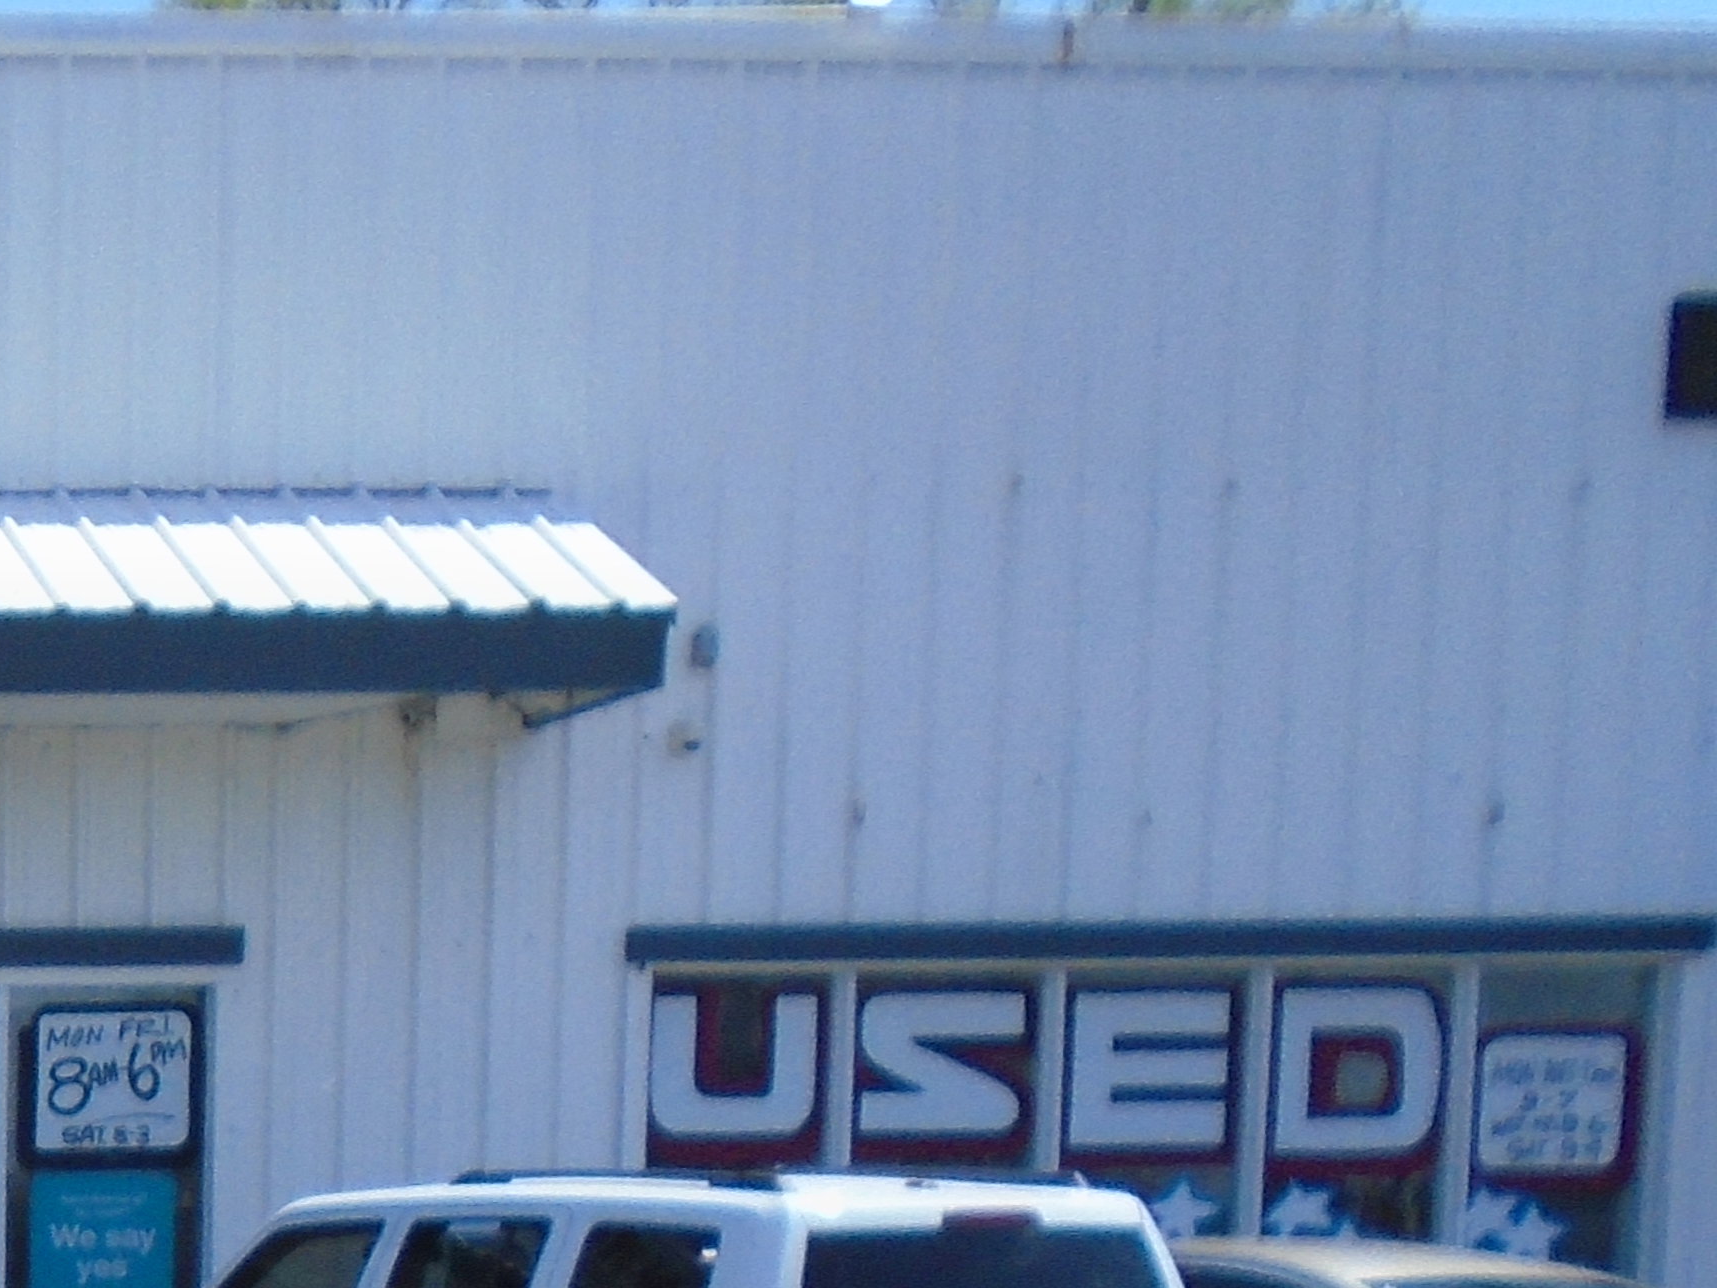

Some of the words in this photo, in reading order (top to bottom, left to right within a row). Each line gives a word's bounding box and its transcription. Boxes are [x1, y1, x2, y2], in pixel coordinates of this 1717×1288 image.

[46, 1024, 105, 1050] MON
[119, 1015, 169, 1040] FRI
[647, 983, 1445, 1158] USED
[61, 1124, 105, 1145] SAT
[48, 1222, 97, 1249] We
[105, 1227, 157, 1255] say
[76, 1257, 128, 1285] yes
